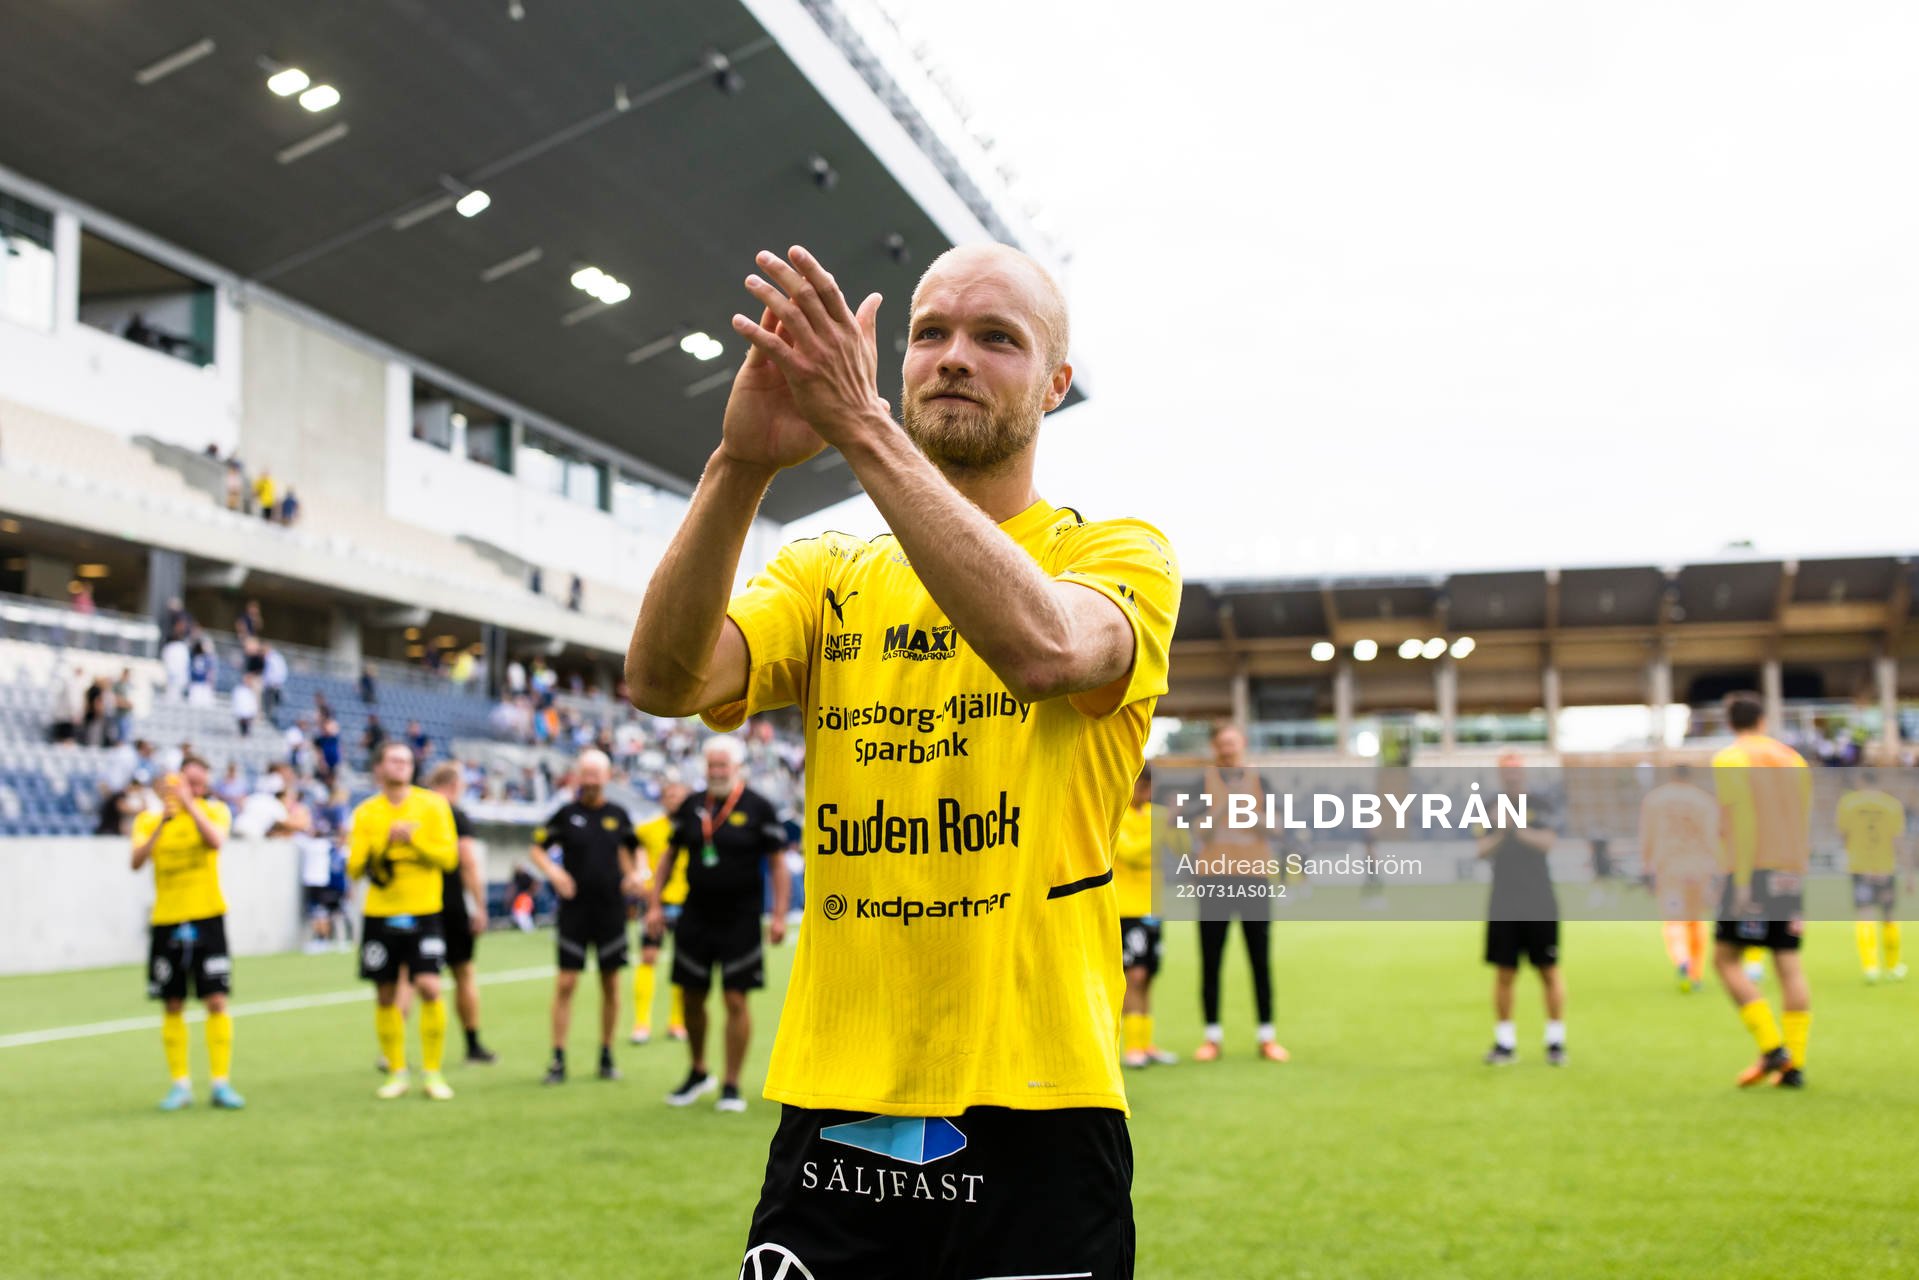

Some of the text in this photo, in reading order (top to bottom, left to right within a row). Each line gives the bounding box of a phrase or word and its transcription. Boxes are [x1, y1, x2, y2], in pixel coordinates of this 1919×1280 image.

[883, 624, 957, 652] MAXI
[855, 732, 969, 766] Sparbank
[817, 791, 1020, 856] Swden Rock
[857, 892, 1011, 926] Kndpartner
[803, 1158, 983, 1203] SÄLJFAST
